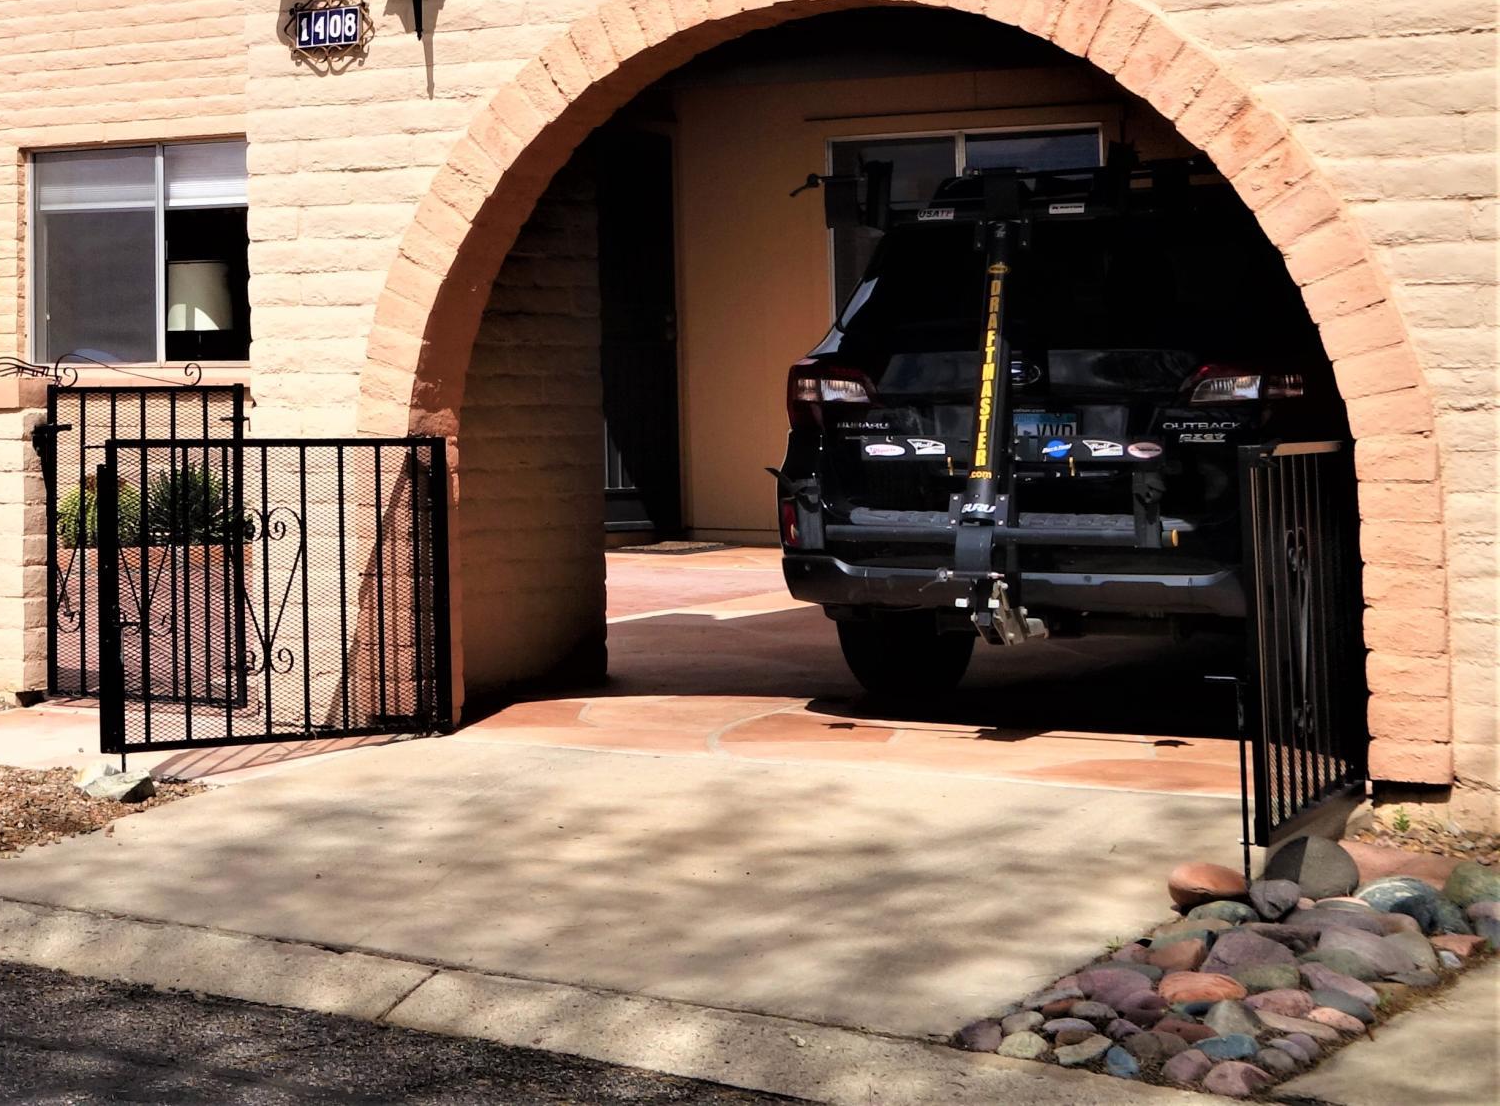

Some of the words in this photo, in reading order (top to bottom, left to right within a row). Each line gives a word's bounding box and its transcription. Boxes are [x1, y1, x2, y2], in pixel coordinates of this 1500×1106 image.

[301, 13, 356, 42] 1408
[975, 280, 1002, 467] DRAFTMASTER
[1162, 422, 1240, 430] OUTBACK
[969, 470, 993, 479] .com
